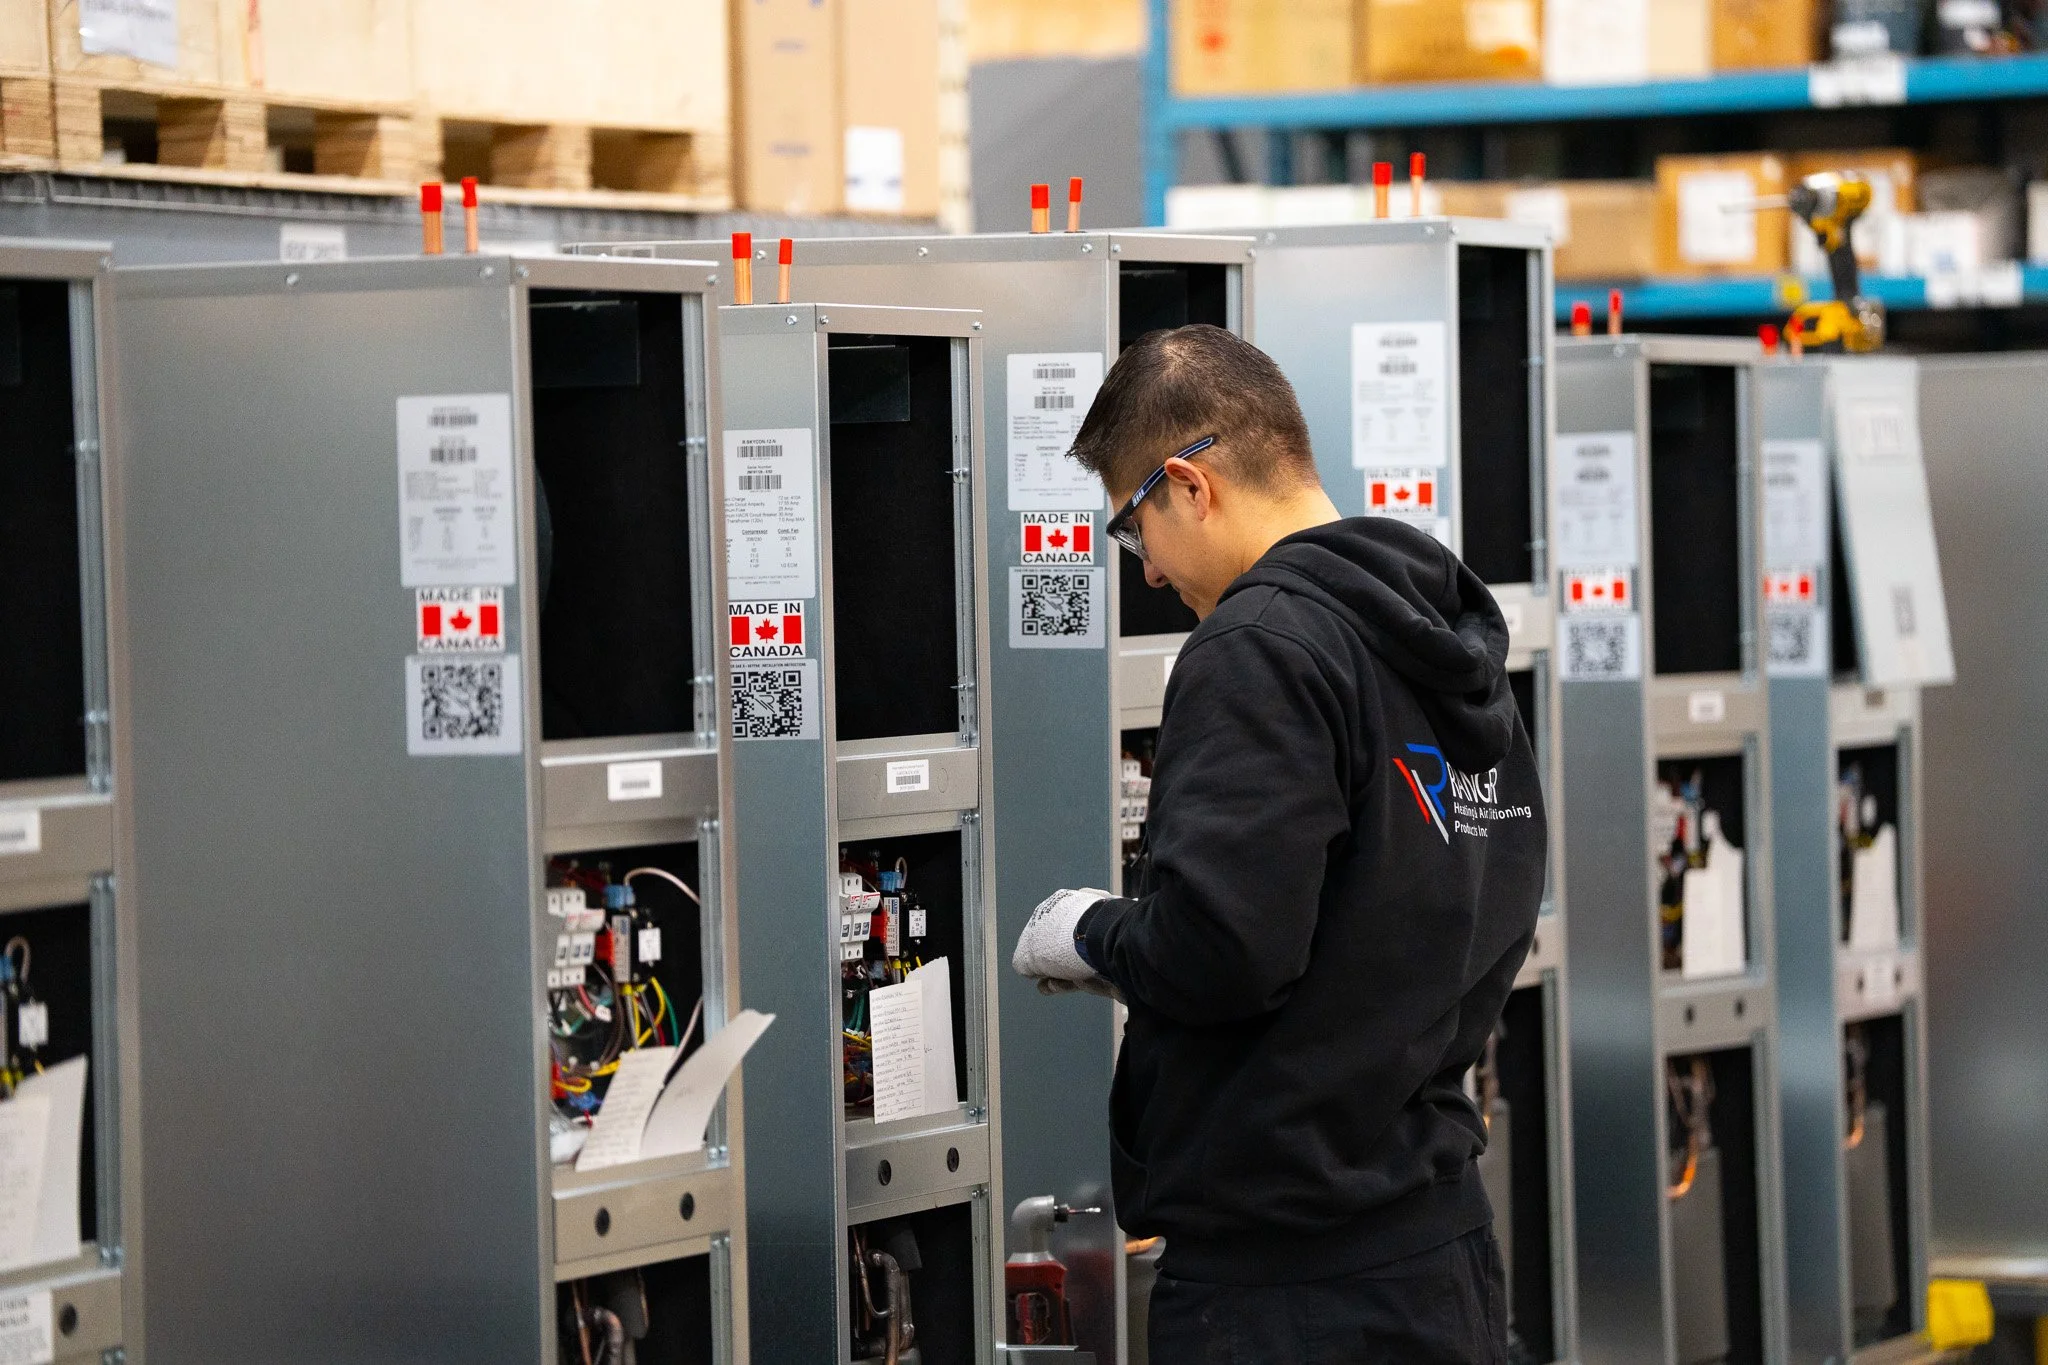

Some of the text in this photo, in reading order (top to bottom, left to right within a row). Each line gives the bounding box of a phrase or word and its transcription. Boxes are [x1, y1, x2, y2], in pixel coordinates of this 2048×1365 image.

[1024, 513, 1090, 523] MADE IN
[1023, 553, 1091, 563] CANADA
[420, 588, 498, 601] MADE IN
[729, 602, 800, 615] MADE IN
[419, 638, 499, 650] CANADA
[729, 645, 803, 658] CANADA
[1455, 821, 1478, 836] Products
